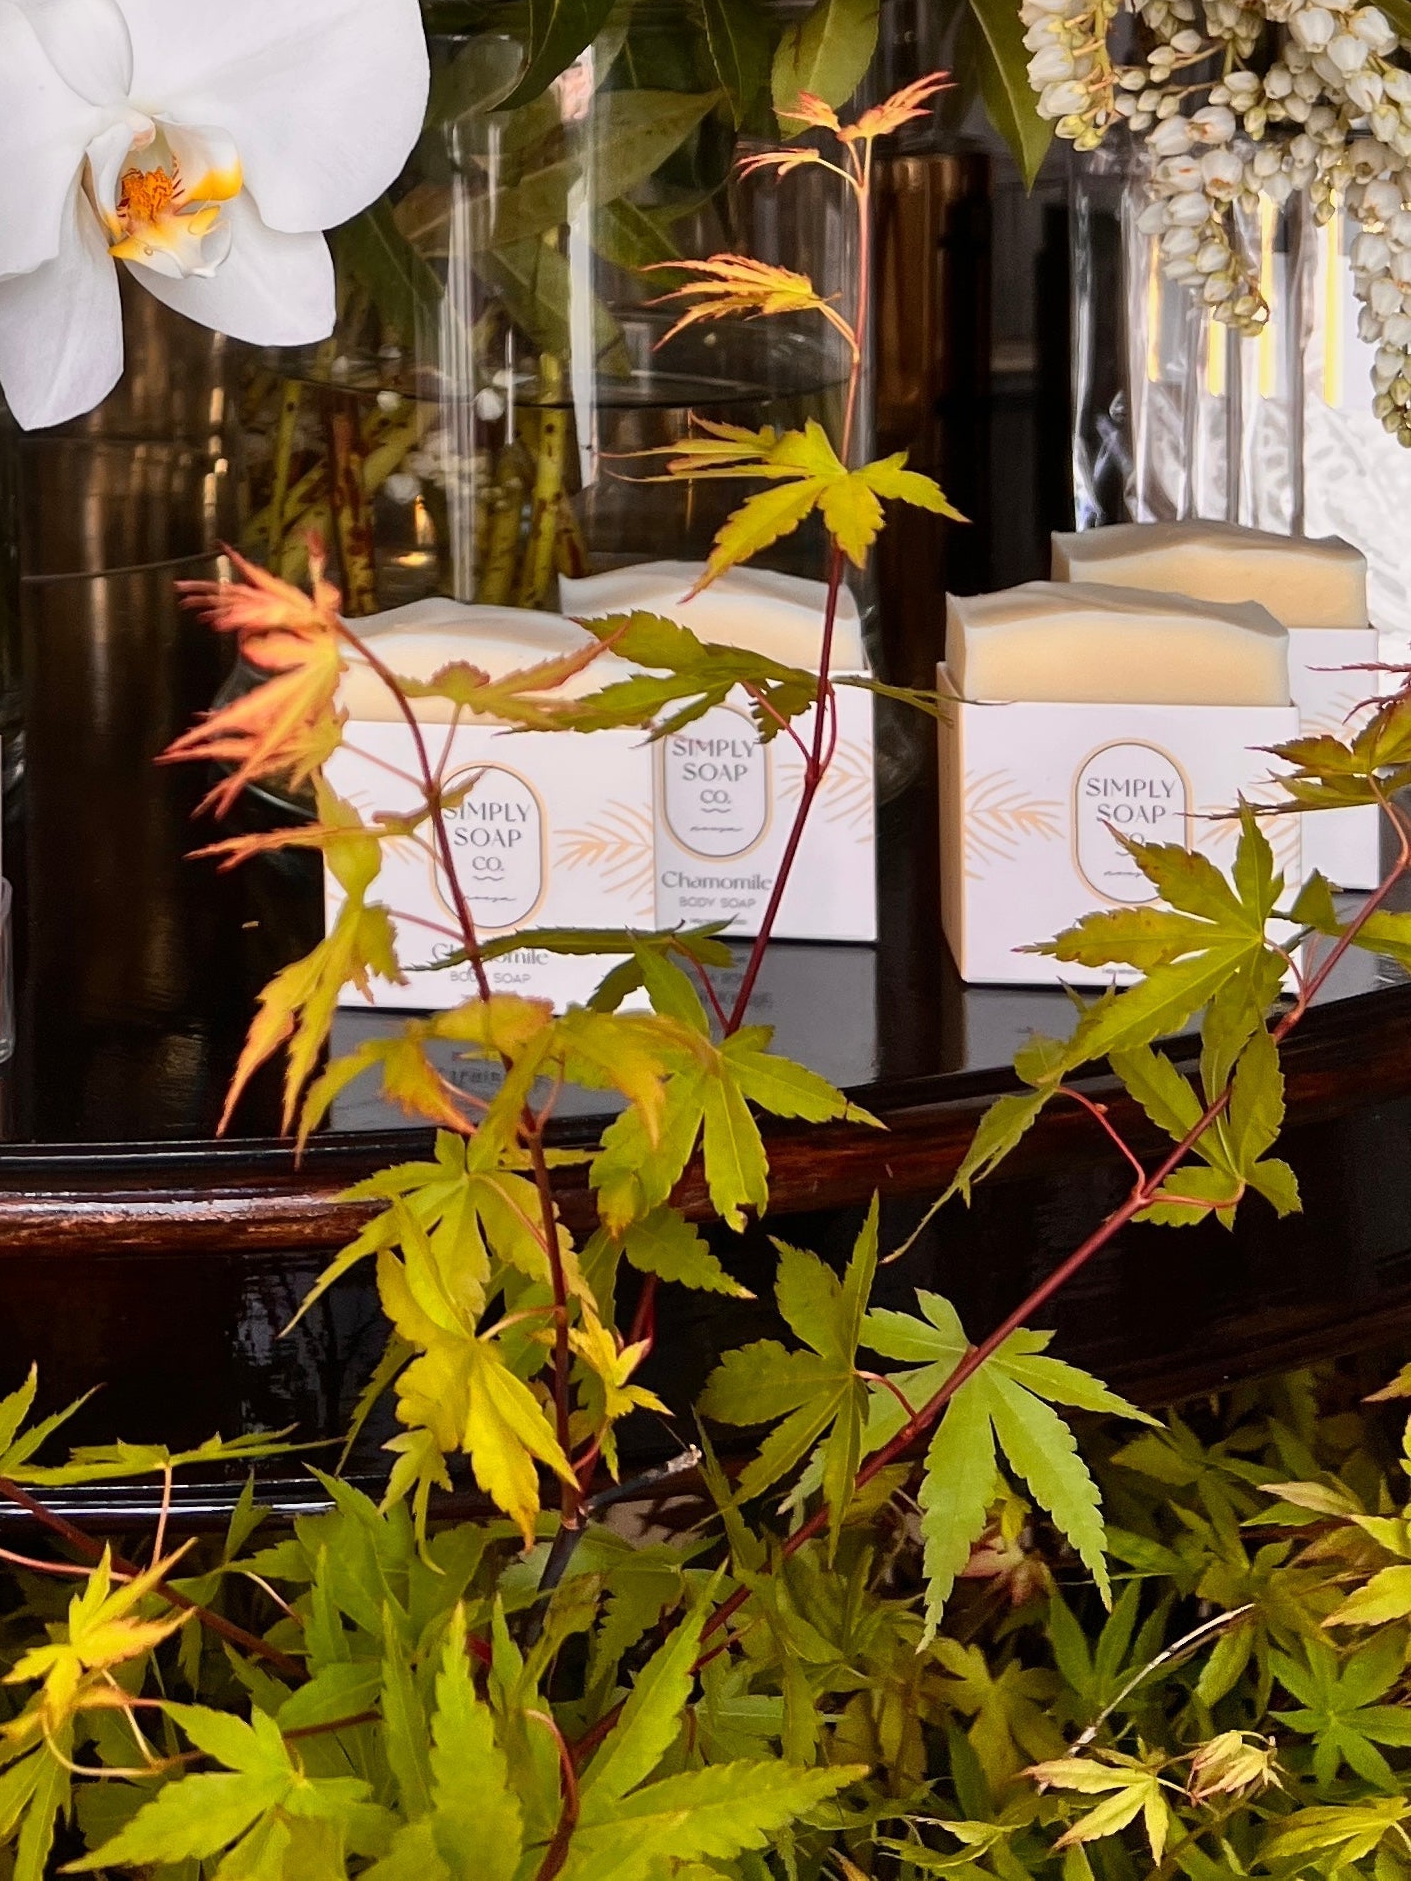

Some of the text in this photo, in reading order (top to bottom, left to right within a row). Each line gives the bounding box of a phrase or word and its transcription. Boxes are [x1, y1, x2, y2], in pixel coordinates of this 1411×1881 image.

[672, 738, 755, 758] SIMPLY
[682, 762, 748, 782] SOAP
[700, 789, 731, 804] CO.
[1085, 777, 1176, 798] SIMPLY
[1096, 803, 1166, 824] SOAP
[453, 826, 522, 848] SOAP
[472, 855, 505, 872] CO.
[661, 870, 773, 891] Chamomile
[679, 896, 757, 909] BODY SOAP
[492, 972, 532, 985] SOAP
